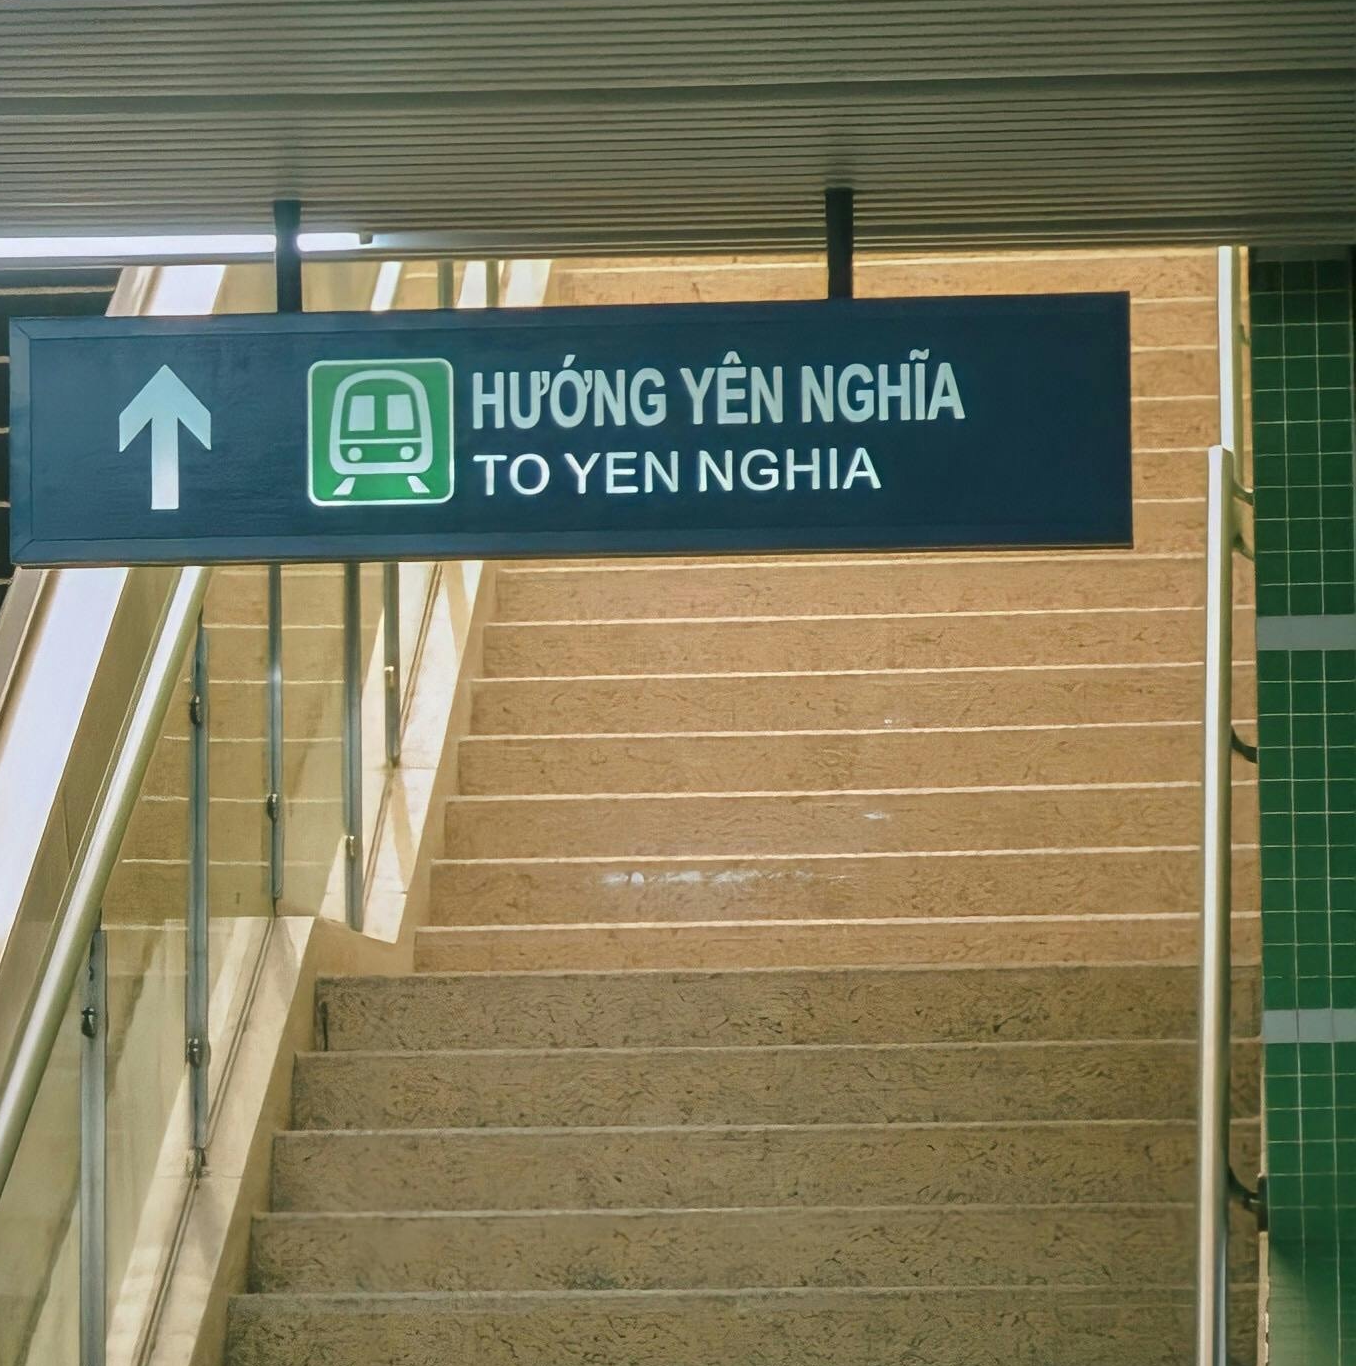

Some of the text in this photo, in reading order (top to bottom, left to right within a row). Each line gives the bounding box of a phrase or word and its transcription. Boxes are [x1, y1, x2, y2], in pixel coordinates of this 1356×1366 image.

[472, 348, 966, 430] HƯỚNG YÊN NGHĨA
[472, 447, 882, 496] TO YEN NGHIA
